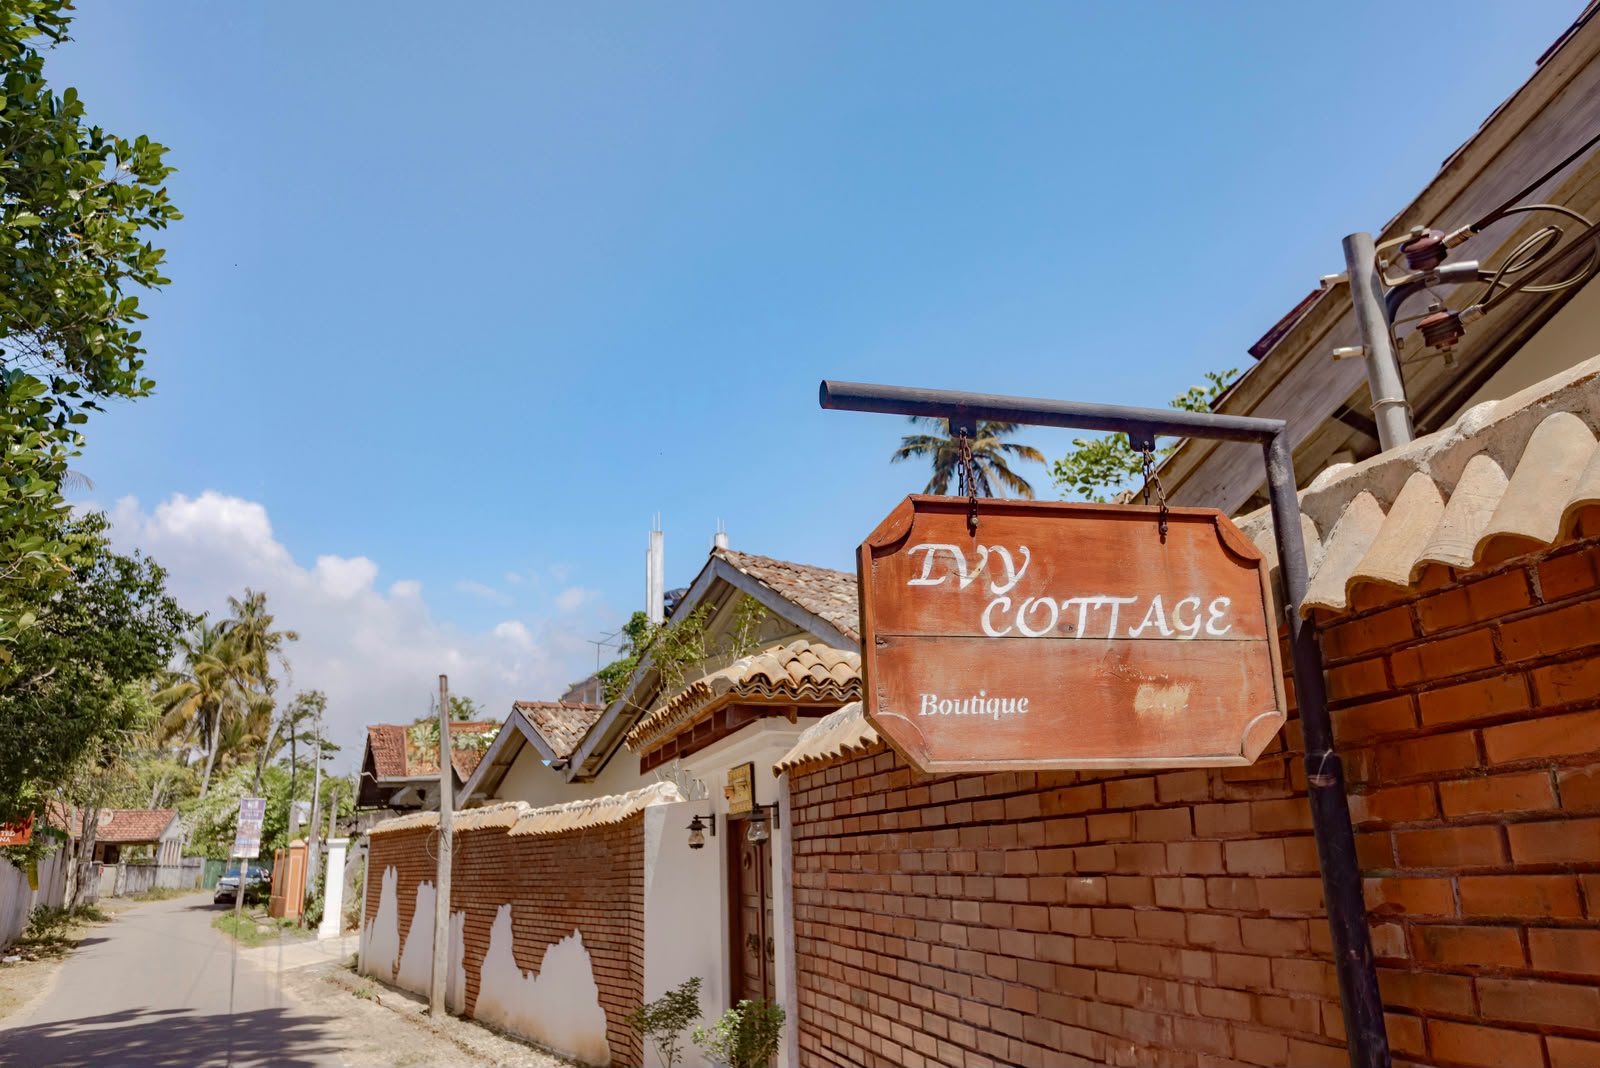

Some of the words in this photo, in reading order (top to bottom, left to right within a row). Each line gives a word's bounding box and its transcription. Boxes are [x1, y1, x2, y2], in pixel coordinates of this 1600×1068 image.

[907, 543, 1030, 595] IVY
[981, 594, 1232, 641] COTTAGE
[918, 691, 1030, 721] Boutique
